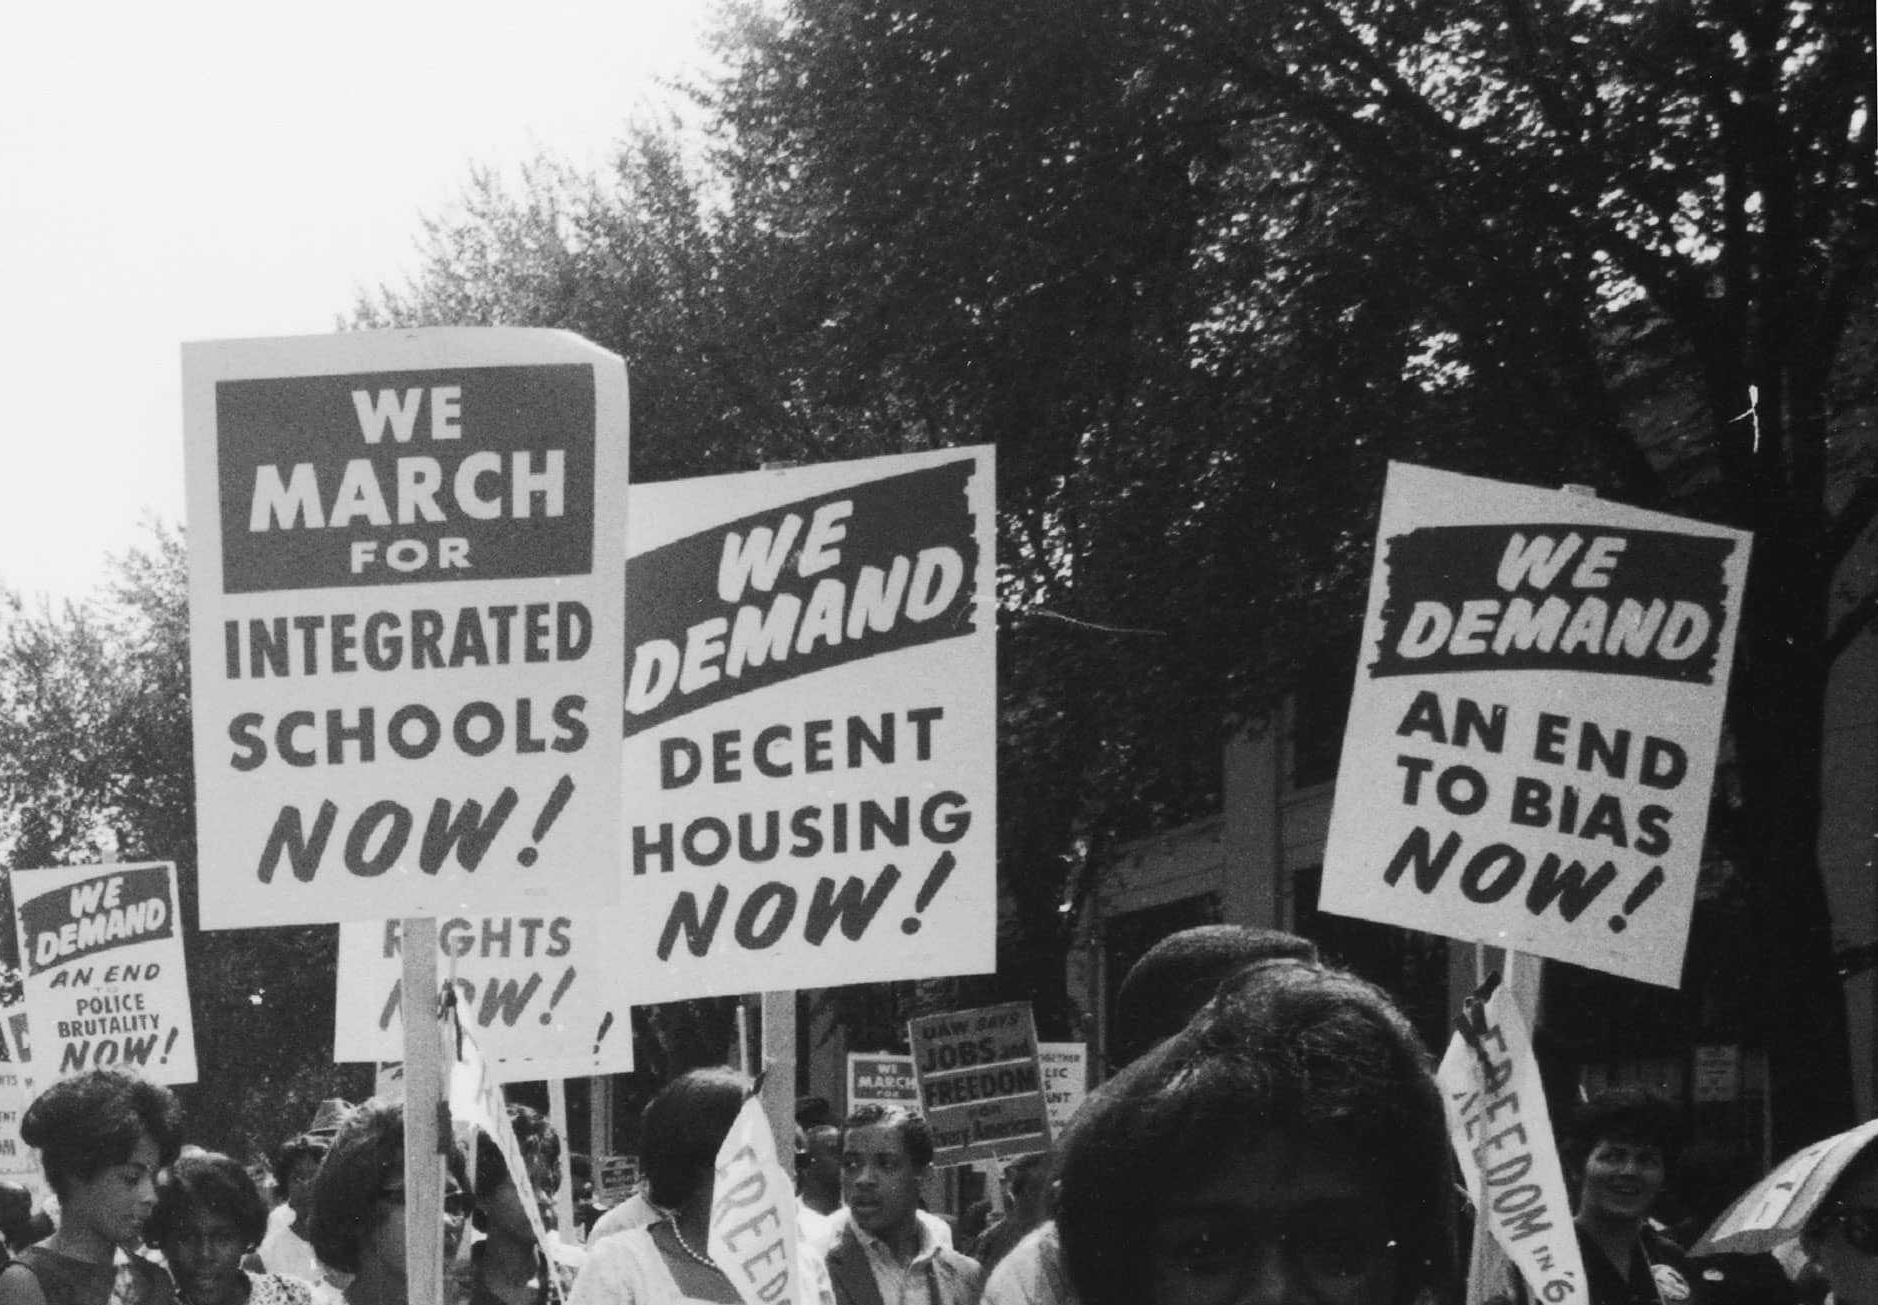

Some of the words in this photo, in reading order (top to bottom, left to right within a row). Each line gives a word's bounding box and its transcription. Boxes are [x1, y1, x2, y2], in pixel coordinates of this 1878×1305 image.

[351, 385, 462, 444] WE
[249, 449, 566, 531] MARCH
[350, 537, 472, 574] FOR
[718, 500, 854, 603] WE
[1496, 532, 1627, 592] WE
[225, 600, 593, 679] INTEGRATED
[624, 546, 964, 715] DEMAND
[1396, 596, 1710, 660] DEMAND
[228, 695, 590, 772] SCHOOLS
[660, 706, 944, 790] DECENT
[1396, 690, 1509, 754] AN
[1534, 712, 1688, 790] END
[257, 774, 576, 884] NOW!
[632, 790, 971, 876] HOUSING
[1397, 754, 1489, 816] TO
[1511, 776, 1673, 858] BIAS
[70, 877, 123, 918] WE
[657, 850, 956, 962] NOW!
[1383, 826, 1665, 934] NOW!
[36, 898, 167, 966] DEMAND
[383, 916, 572, 958] RGHTS
[50, 967, 94, 989] AN
[104, 963, 161, 983] END
[77, 993, 144, 1016] POLICE
[58, 1013, 160, 1038] BRUTALITY
[60, 1026, 178, 1073] NOW!
[923, 1037, 995, 1072] JOBS
[857, 1075, 917, 1089] MARCH
[925, 1066, 1039, 1107] FREEDOM
[1530, 1244, 1556, 1273] IN
